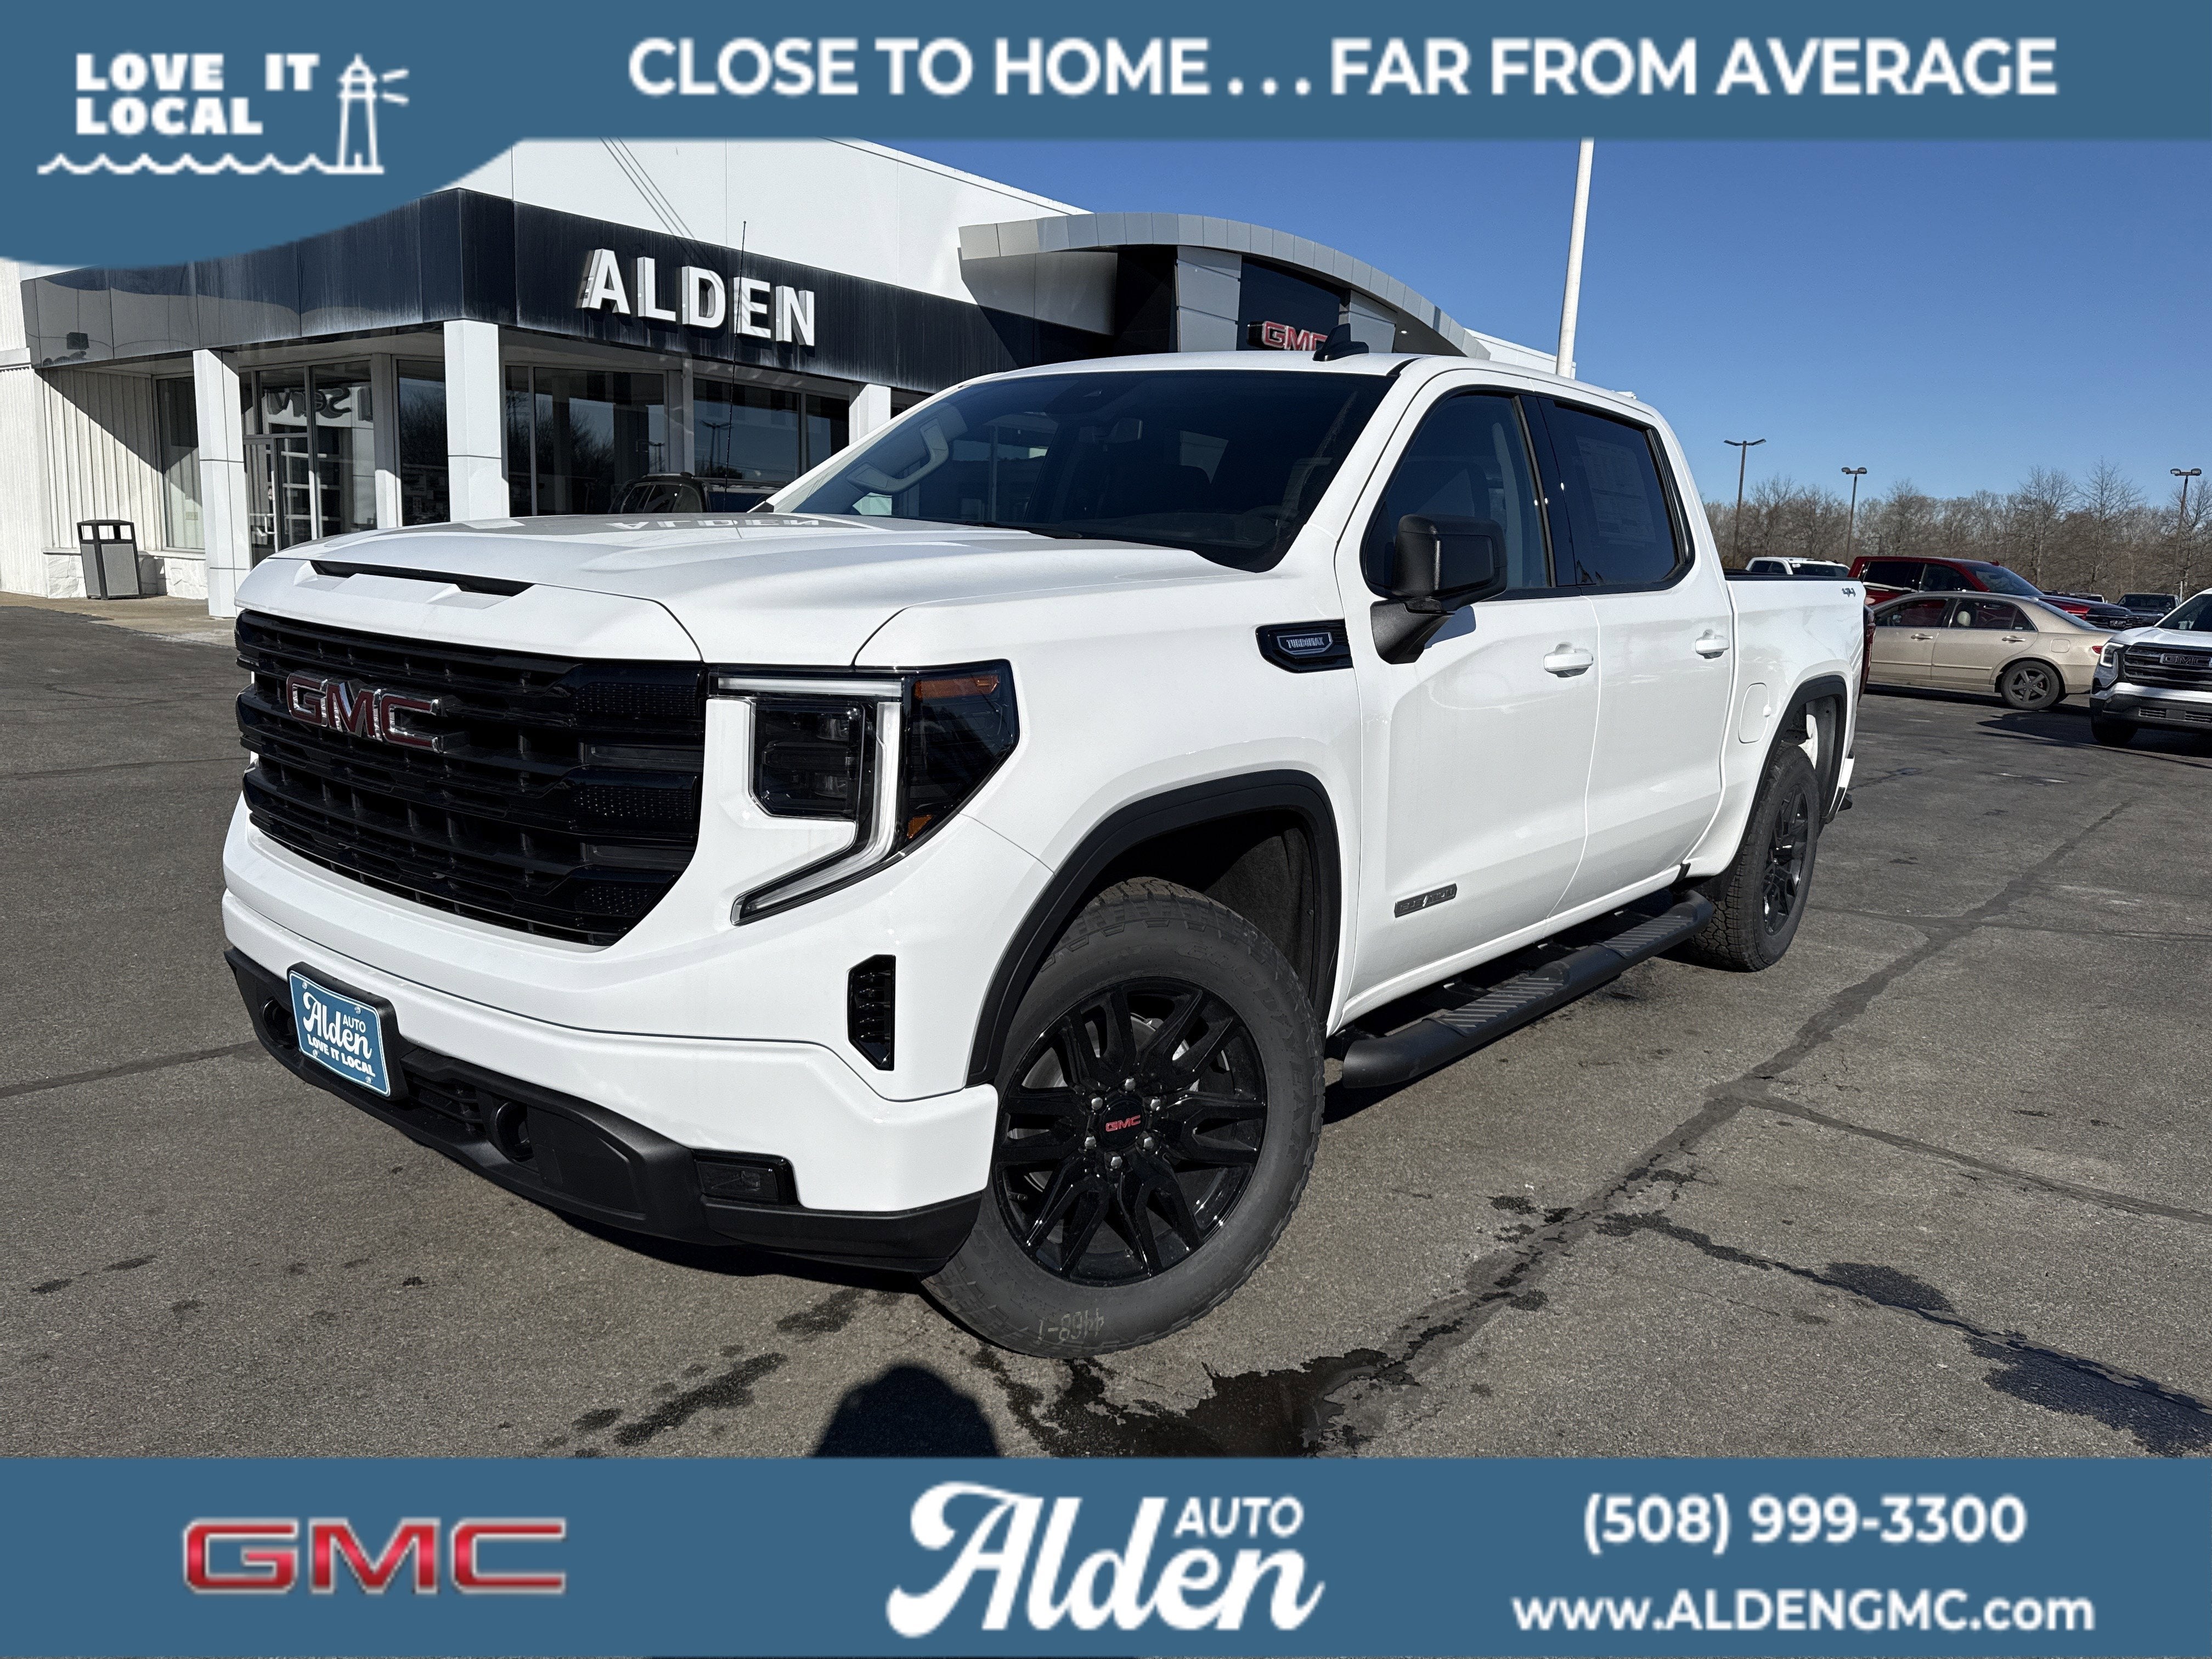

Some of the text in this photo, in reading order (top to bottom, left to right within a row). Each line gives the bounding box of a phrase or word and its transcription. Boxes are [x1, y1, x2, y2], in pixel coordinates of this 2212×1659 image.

[582, 248, 815, 347] ALDEN
[286, 670, 441, 754] GMC
[303, 991, 373, 1059] Alden
[342, 1014, 366, 1033] AUTO
[307, 1034, 376, 1077] LOVE IT LOCAL
[1105, 1114, 1141, 1132] GMC
